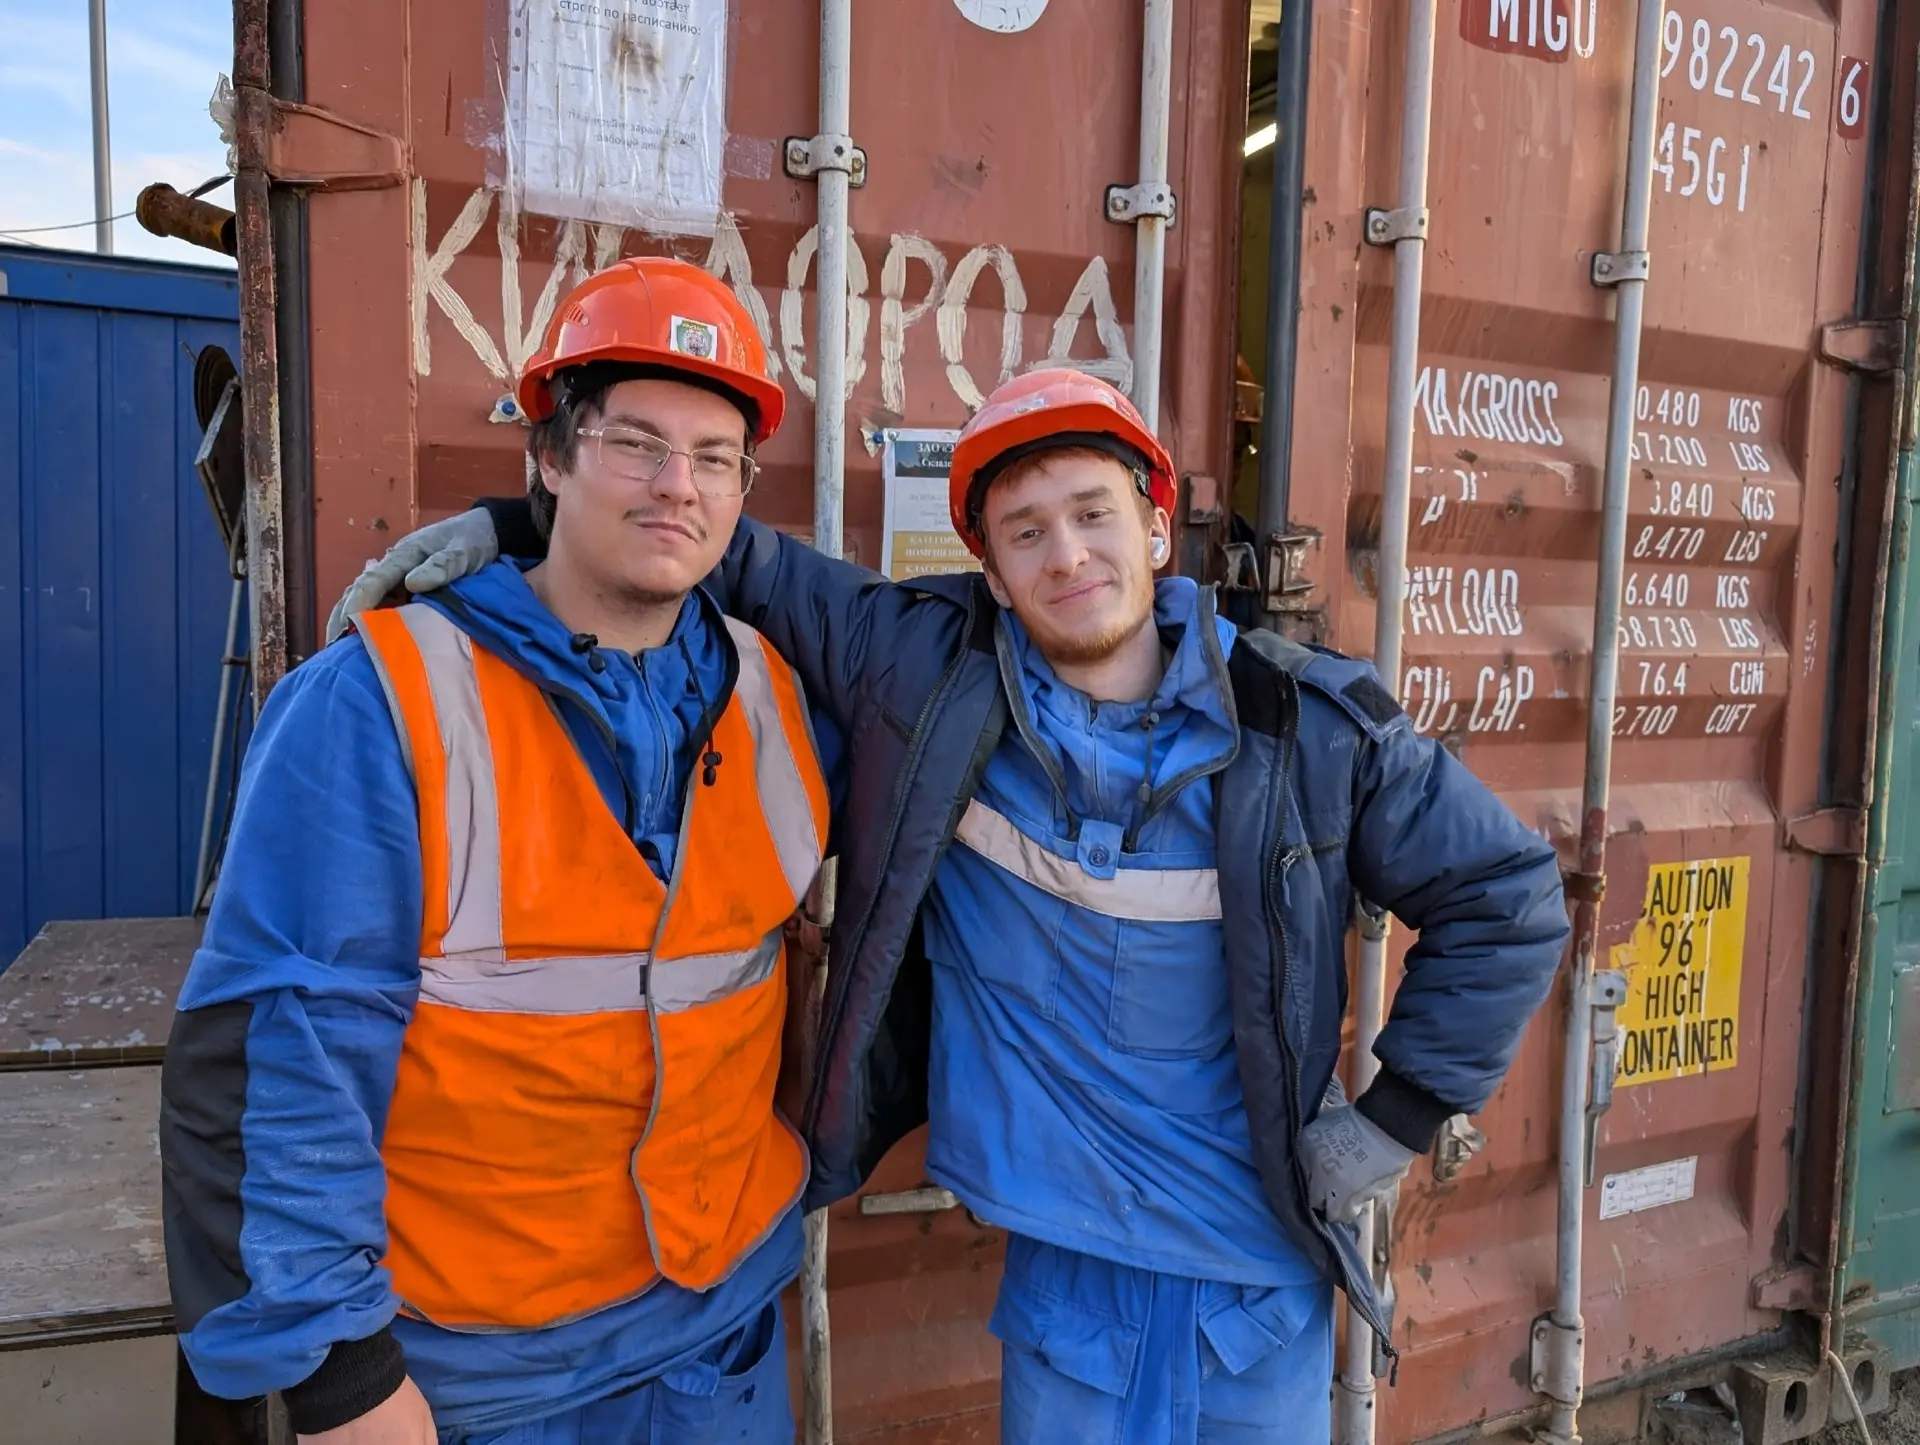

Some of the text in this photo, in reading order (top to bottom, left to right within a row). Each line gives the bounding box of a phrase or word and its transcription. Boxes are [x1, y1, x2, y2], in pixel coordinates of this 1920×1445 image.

[604, 9, 619, 19] по
[1489, 0, 1862, 127] MIGU 982242 6
[1652, 122, 1750, 212] 45G1
[411, 176, 1134, 412] КИЛОРОД
[1727, 397, 1762, 434] KGS
[1729, 441, 1770, 472] LBS
[1741, 486, 1775, 521] KGS
[1723, 530, 1767, 562] LBS
[1716, 575, 1750, 608] KGS
[1719, 617, 1759, 648] LBS
[1639, 662, 1764, 696] 76.4 CUM
[1705, 704, 1757, 734] CUFT
[1641, 866, 1734, 918] AUTION
[1645, 970, 1705, 1021] HIGH
[1617, 1017, 1734, 1077] ONTAINER
